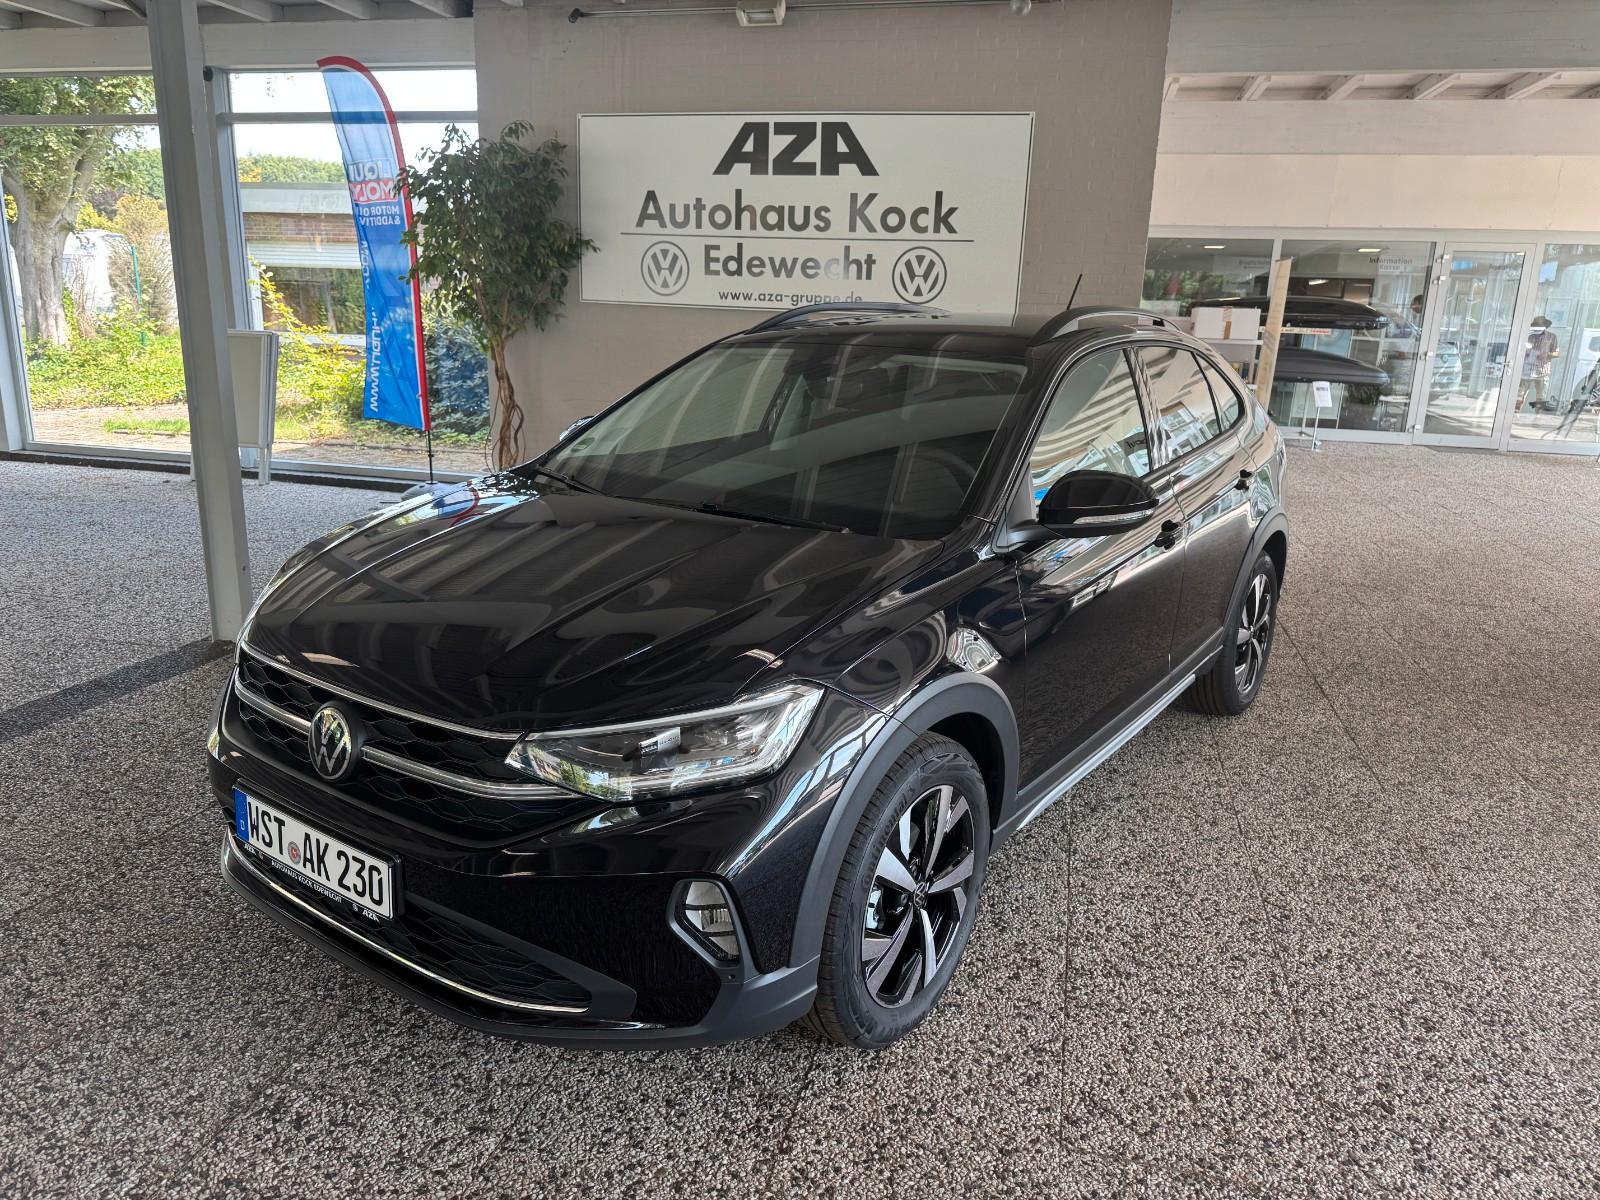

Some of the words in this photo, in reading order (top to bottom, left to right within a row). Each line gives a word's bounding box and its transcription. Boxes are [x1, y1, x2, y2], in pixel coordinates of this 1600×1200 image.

[712, 121, 880, 177] AZA
[635, 189, 832, 233] Autohaus
[848, 191, 959, 235] Kock
[704, 242, 876, 281] Edewecht
[718, 291, 863, 306] www.aza-gruppe.de
[247, 801, 286, 856] WST
[302, 832, 331, 882] AK
[336, 850, 384, 907] 230
